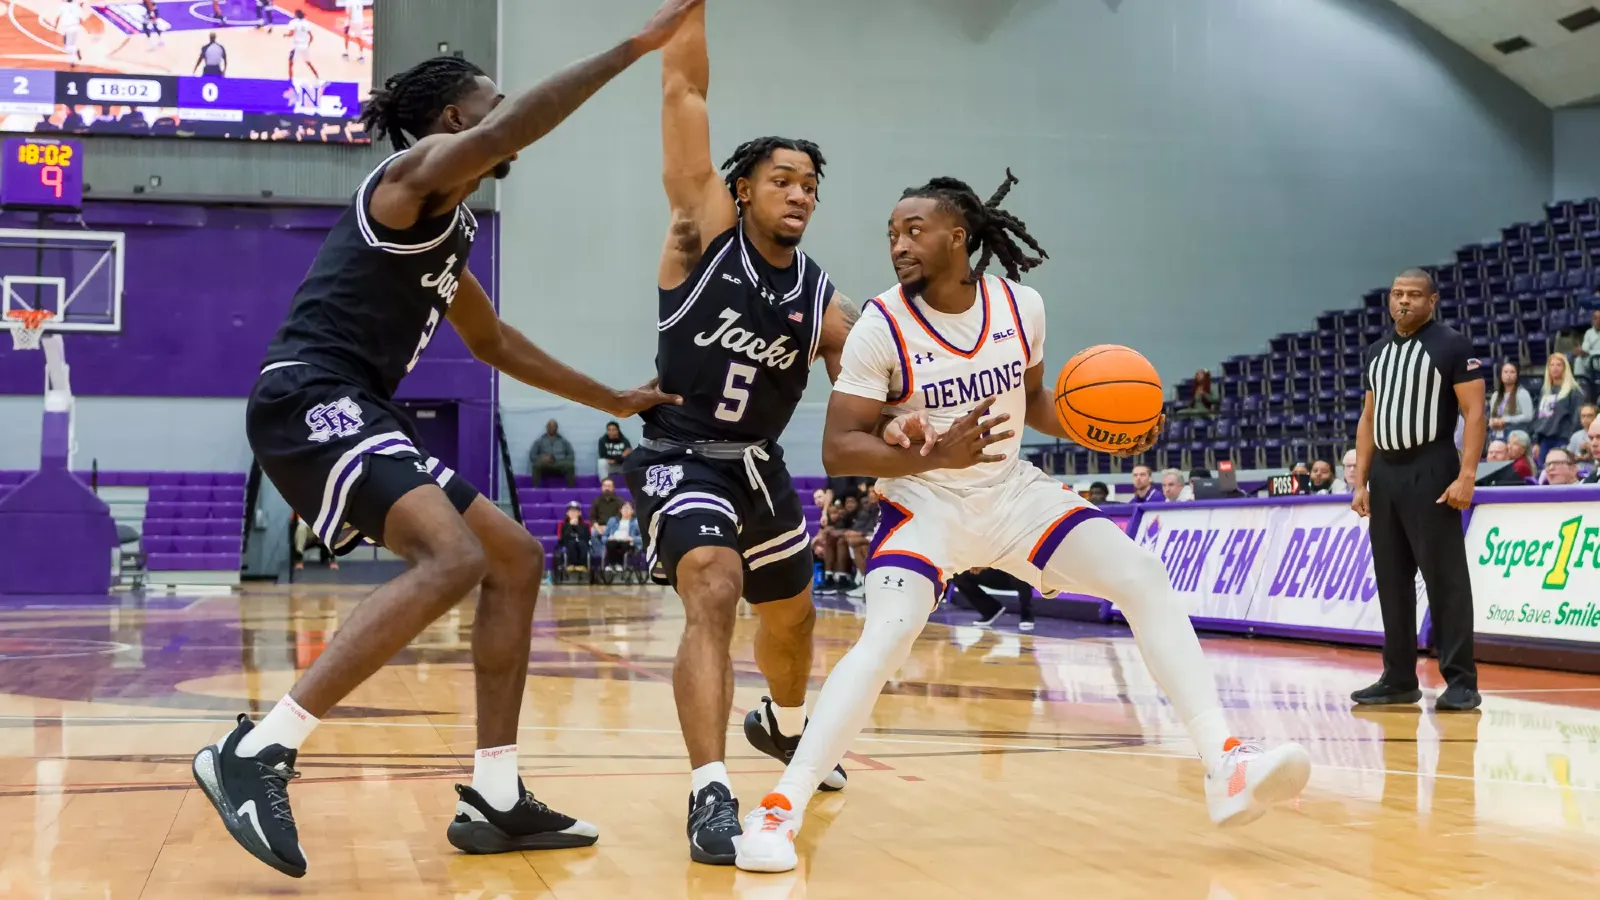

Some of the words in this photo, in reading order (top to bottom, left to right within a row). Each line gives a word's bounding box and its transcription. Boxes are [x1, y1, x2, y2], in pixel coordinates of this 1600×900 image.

[12, 76, 30, 95] 2
[100, 84, 149, 97] 18:02
[202, 82, 219, 102] 0
[18, 143, 73, 167] 18:02
[41, 165, 63, 198] 9
[721, 273, 742, 285] SLC
[693, 307, 800, 371] Jacks
[992, 329, 1015, 341] SLC
[714, 361, 757, 423] 5
[921, 360, 1022, 409] DEMONS
[307, 402, 361, 434] SFA
[1085, 424, 1146, 446] Wilso
[1273, 476, 1292, 494] POSS
[1160, 529, 1220, 592] FORK
[1478, 526, 1554, 578] Super
[1541, 514, 1583, 590] 1
[1573, 527, 1600, 569] F
[1486, 604, 1515, 625] Shop.
[1517, 603, 1552, 624] Save.
[1554, 601, 1600, 627] Smile
